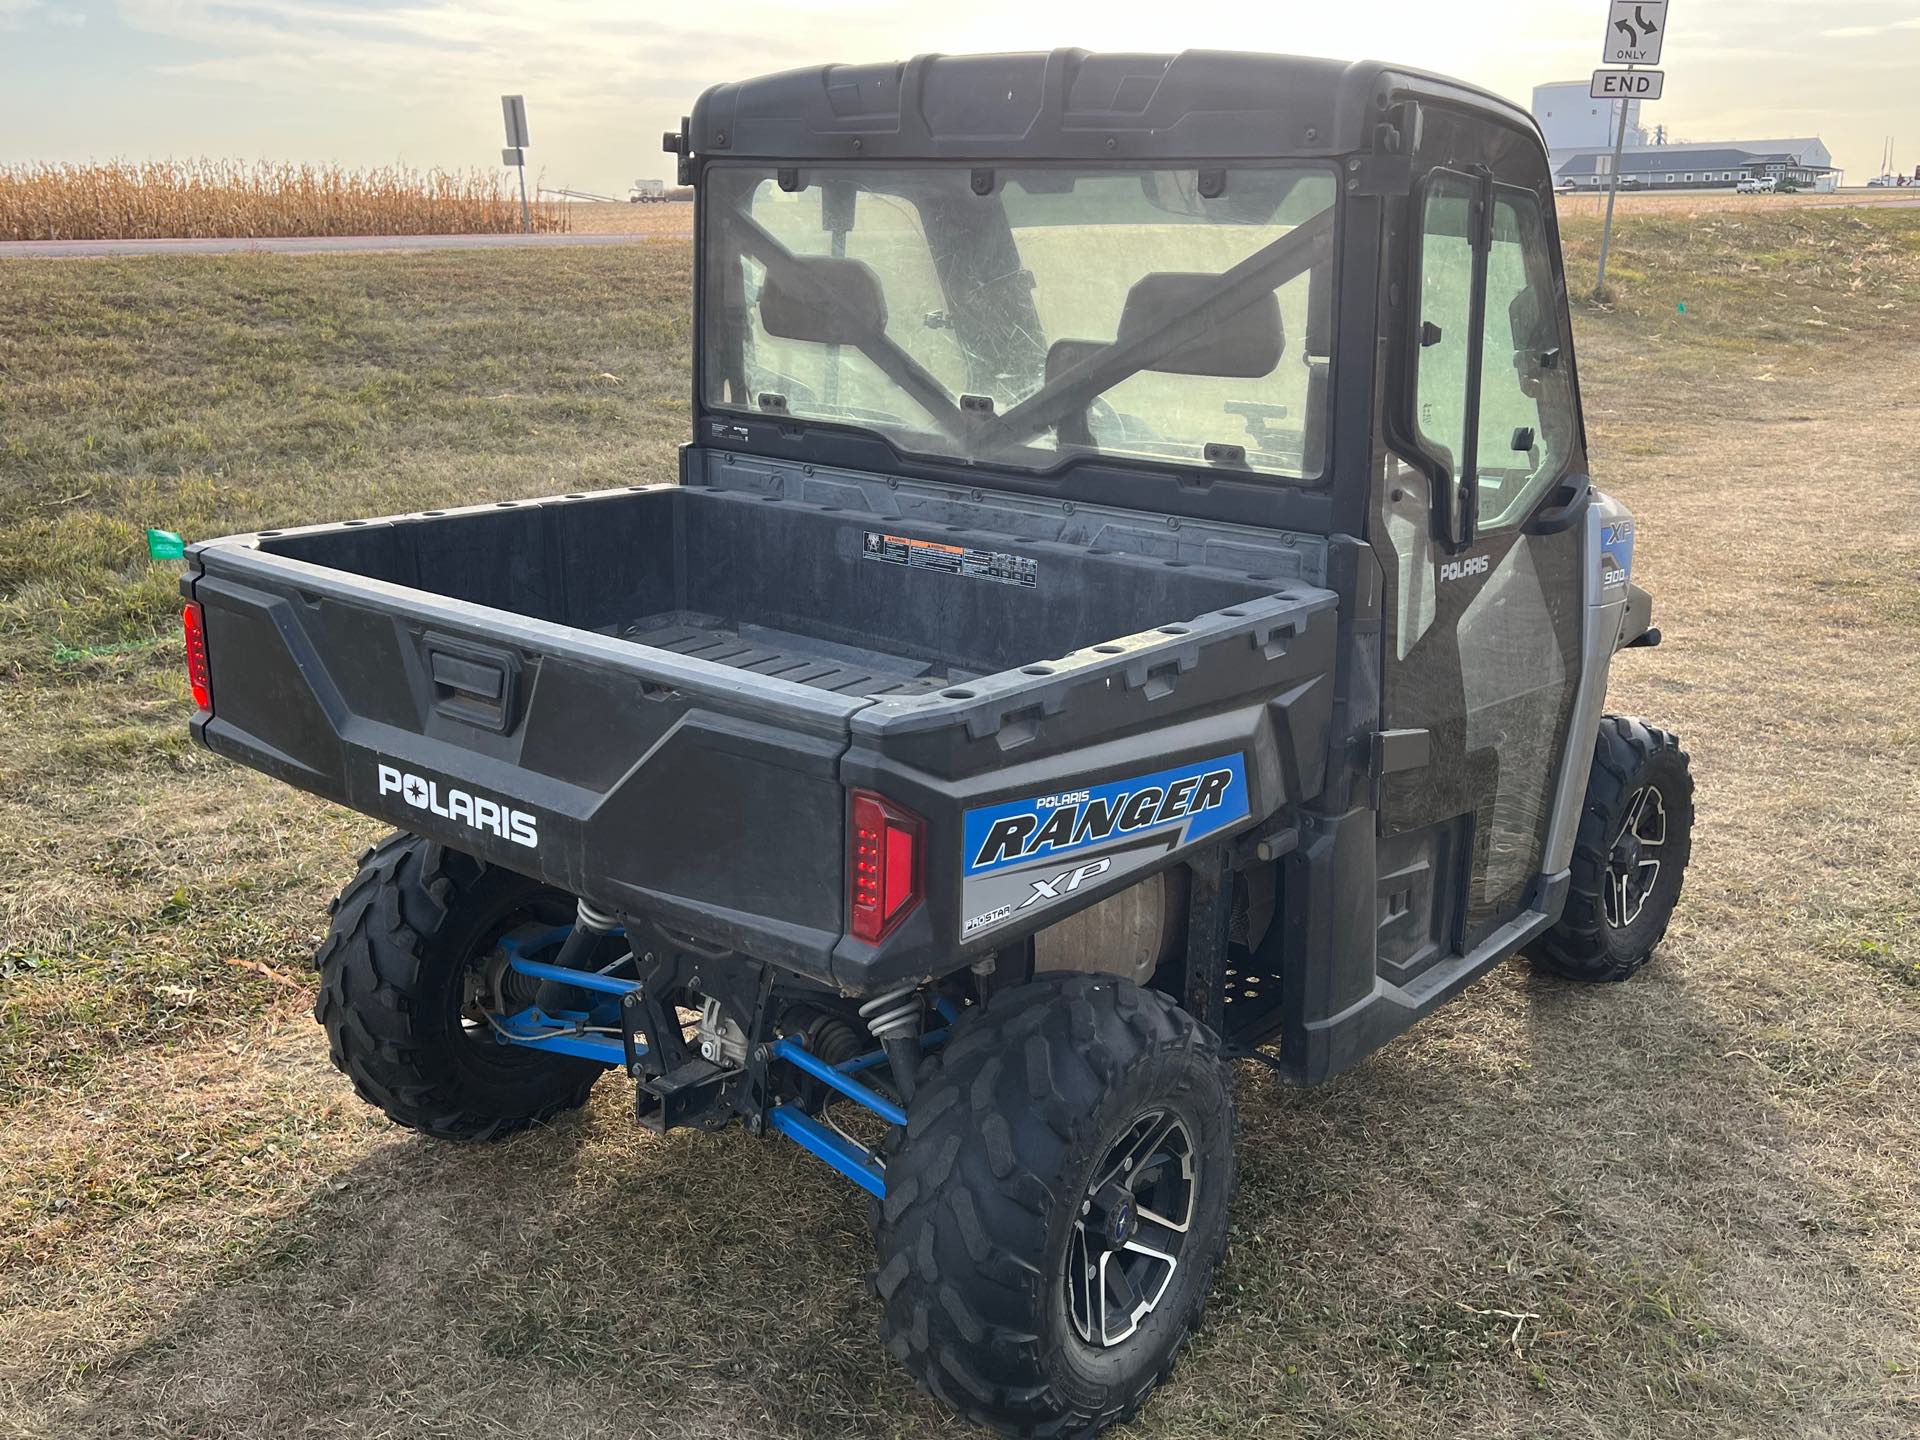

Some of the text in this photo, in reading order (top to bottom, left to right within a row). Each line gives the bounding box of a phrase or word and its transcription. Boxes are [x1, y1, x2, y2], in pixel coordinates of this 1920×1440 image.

[1617, 50, 1646, 59] ONLY
[1604, 77, 1650, 92] END
[1606, 520, 1631, 545] XP
[1441, 555, 1490, 582] POLARIS
[1604, 569, 1625, 584] 900
[378, 764, 538, 848] POLARIS
[1036, 790, 1090, 809] POLARIS
[972, 769, 1233, 869] RANGER
[1014, 857, 1112, 912] XP
[966, 905, 1010, 931] PROSTAR
